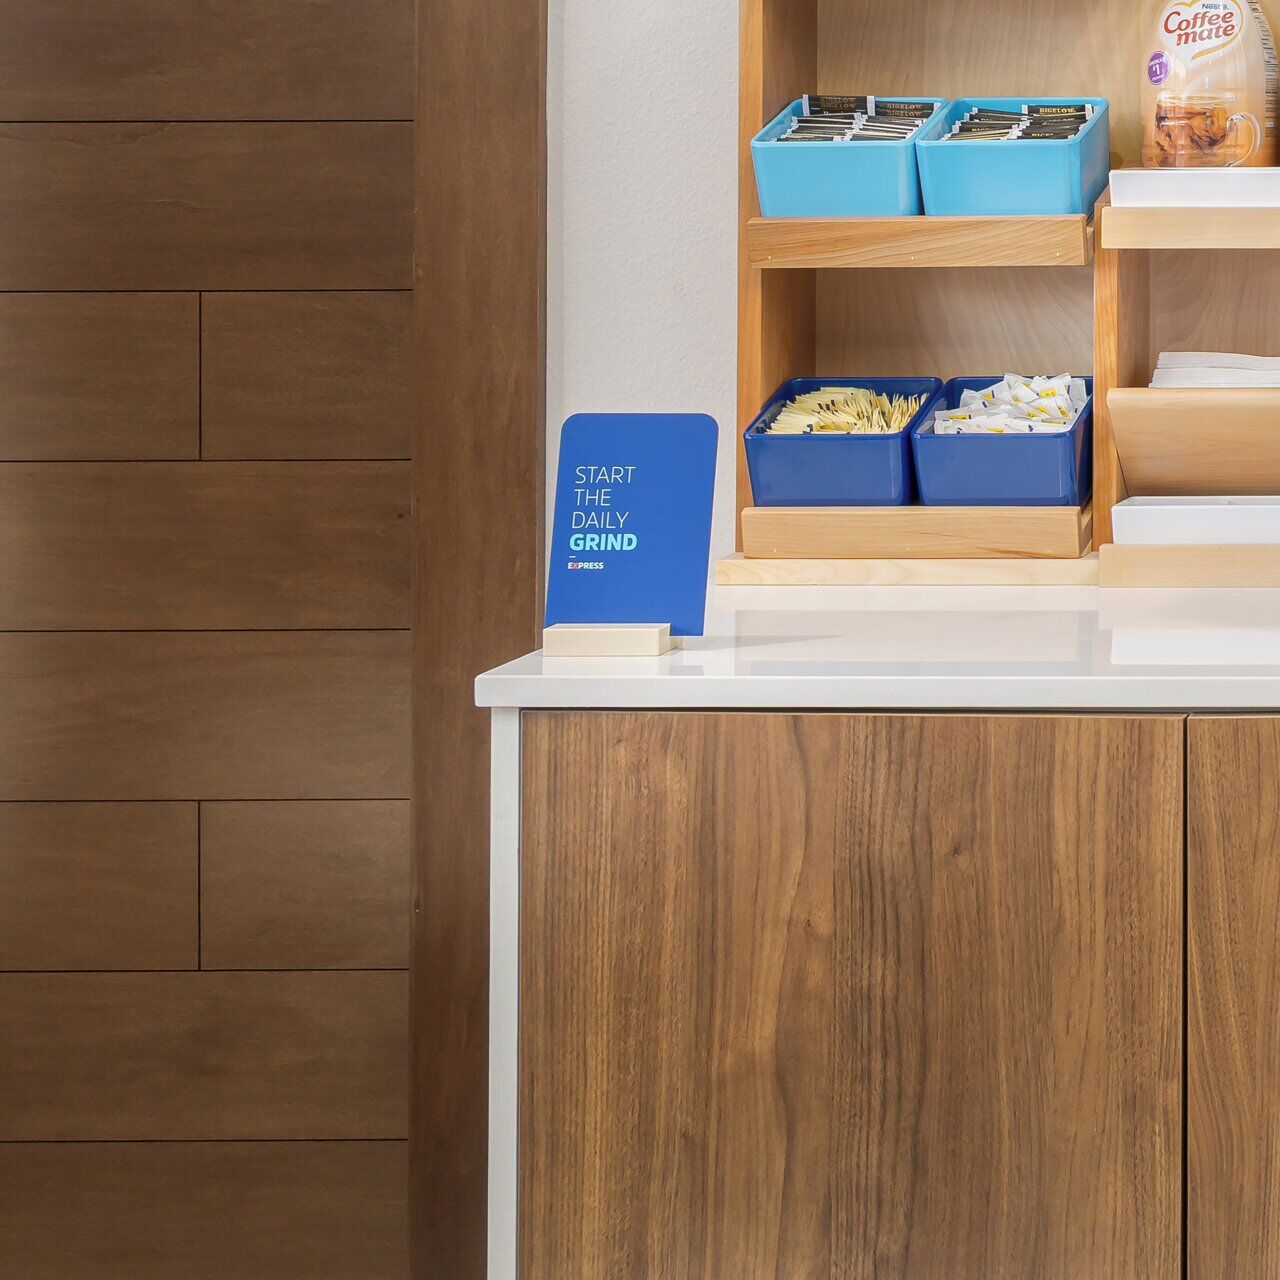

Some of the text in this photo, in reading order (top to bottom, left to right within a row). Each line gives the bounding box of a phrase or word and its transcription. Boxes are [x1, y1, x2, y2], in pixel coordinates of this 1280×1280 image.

[1163, 11, 1234, 34] Coffee
[1176, 24, 1235, 46] mate
[574, 465, 636, 484] START
[574, 488, 612, 506] THE
[571, 511, 629, 529] DAILY
[569, 533, 638, 551] GRIND
[567, 562, 604, 570] EXPRESS
